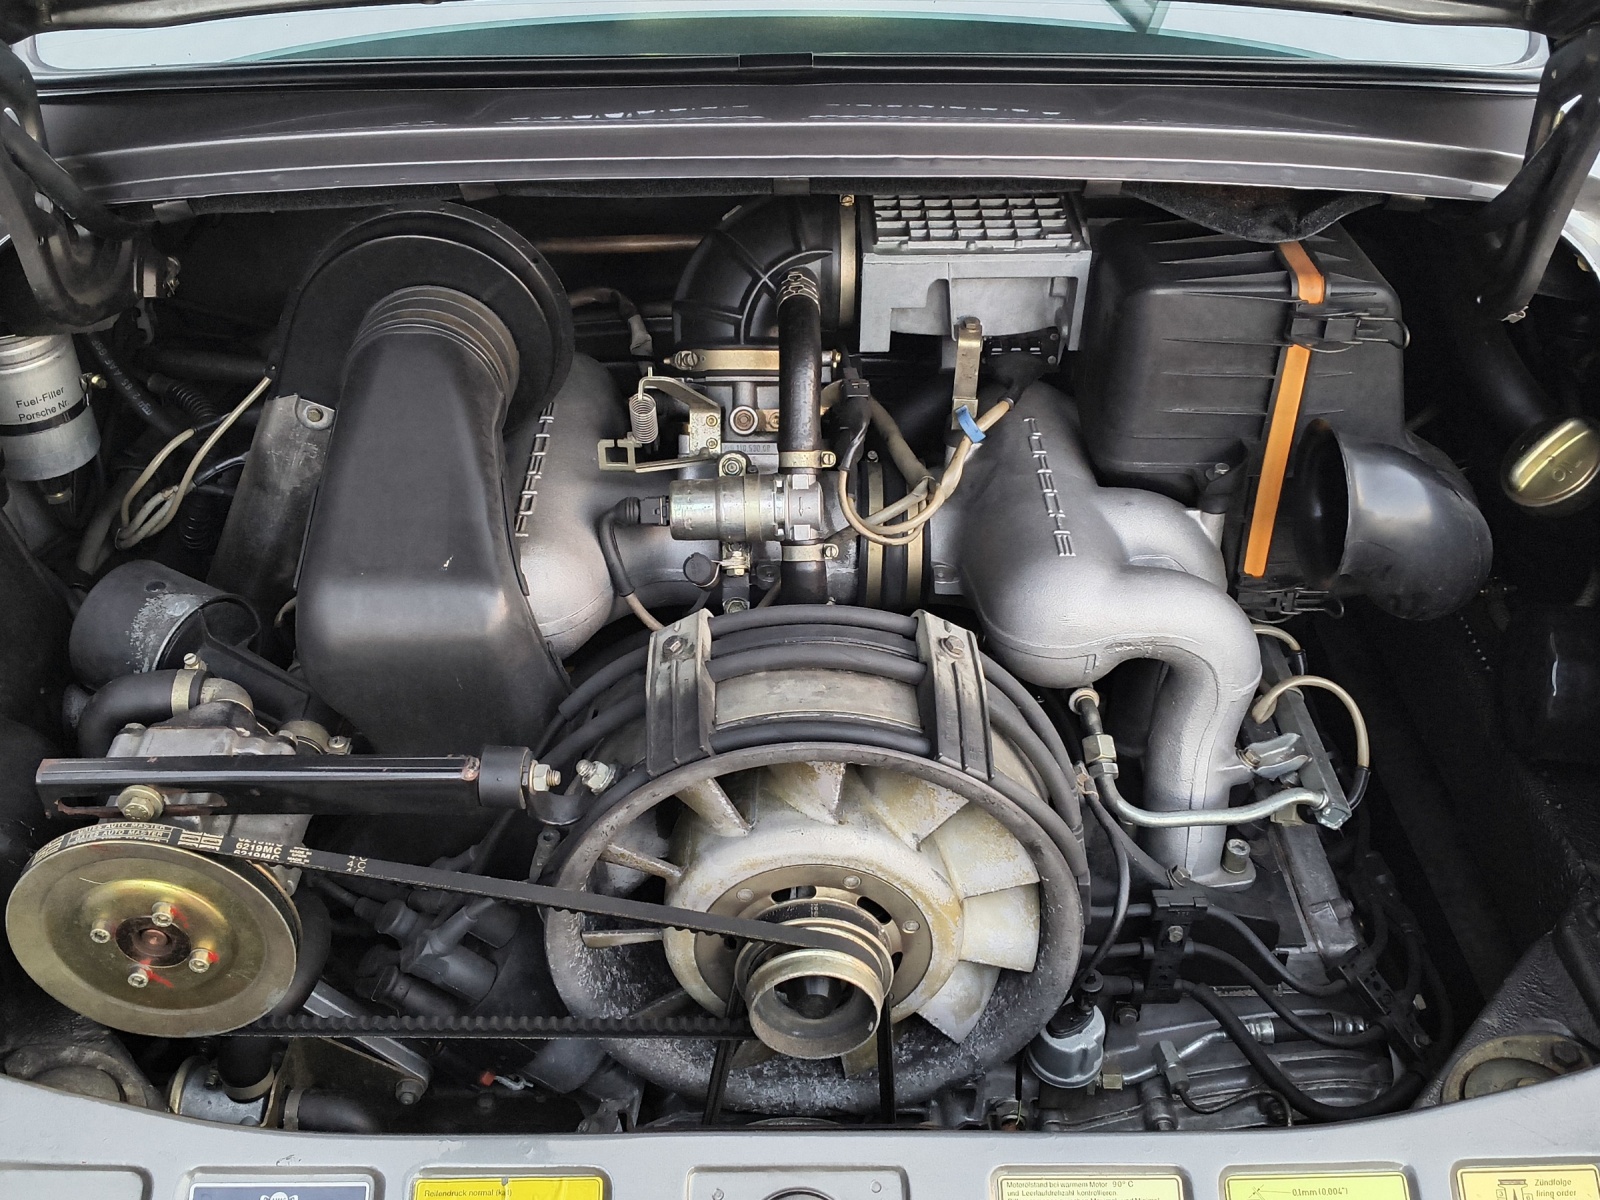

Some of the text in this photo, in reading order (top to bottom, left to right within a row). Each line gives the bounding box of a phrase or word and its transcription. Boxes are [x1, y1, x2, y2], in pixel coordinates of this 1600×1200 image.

[16, 386, 65, 408] Fuel-Filter
[18, 405, 57, 422] Porsche
[236, 842, 283, 854] 6219MC
[1534, 1179, 1572, 1187] Zündfolge
[468, 1189, 494, 1197] normal
[1536, 1190, 1555, 1200] firing
